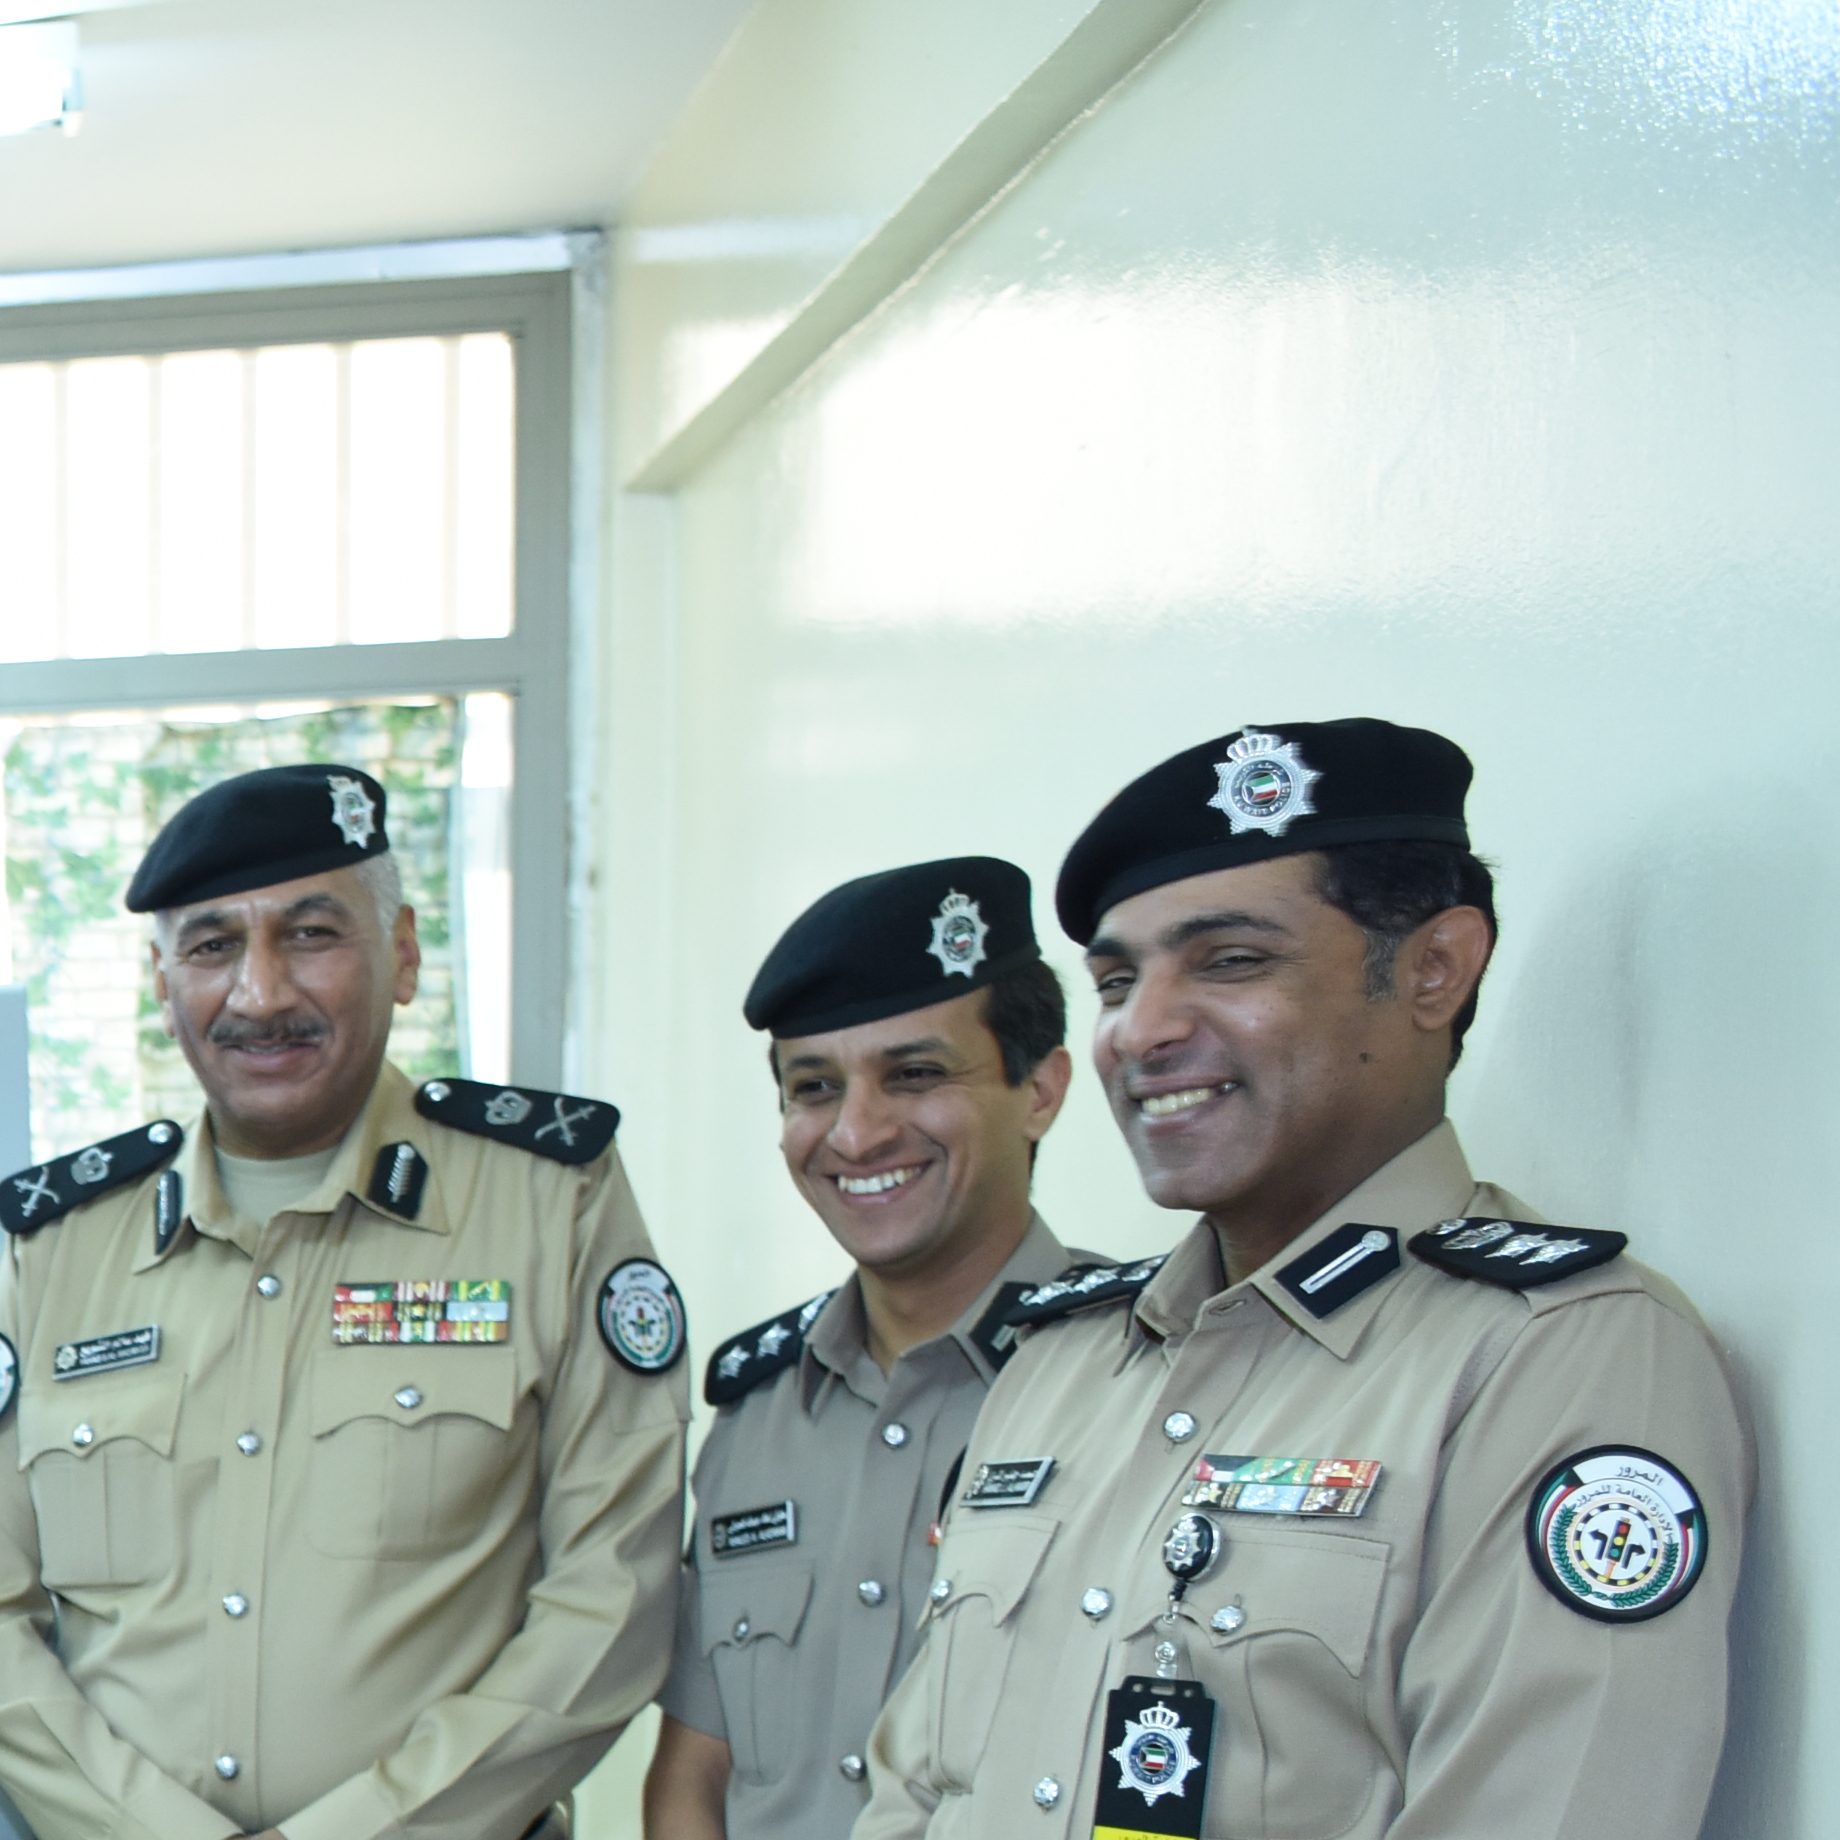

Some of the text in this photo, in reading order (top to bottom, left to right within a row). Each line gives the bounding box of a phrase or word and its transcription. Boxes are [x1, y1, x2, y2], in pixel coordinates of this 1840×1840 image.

[1269, 782, 1291, 812] POLICE
[1615, 1465, 1664, 1487] المرور
[1575, 1483, 1612, 1508] للمرور
[1615, 1483, 1652, 1506] العامة
